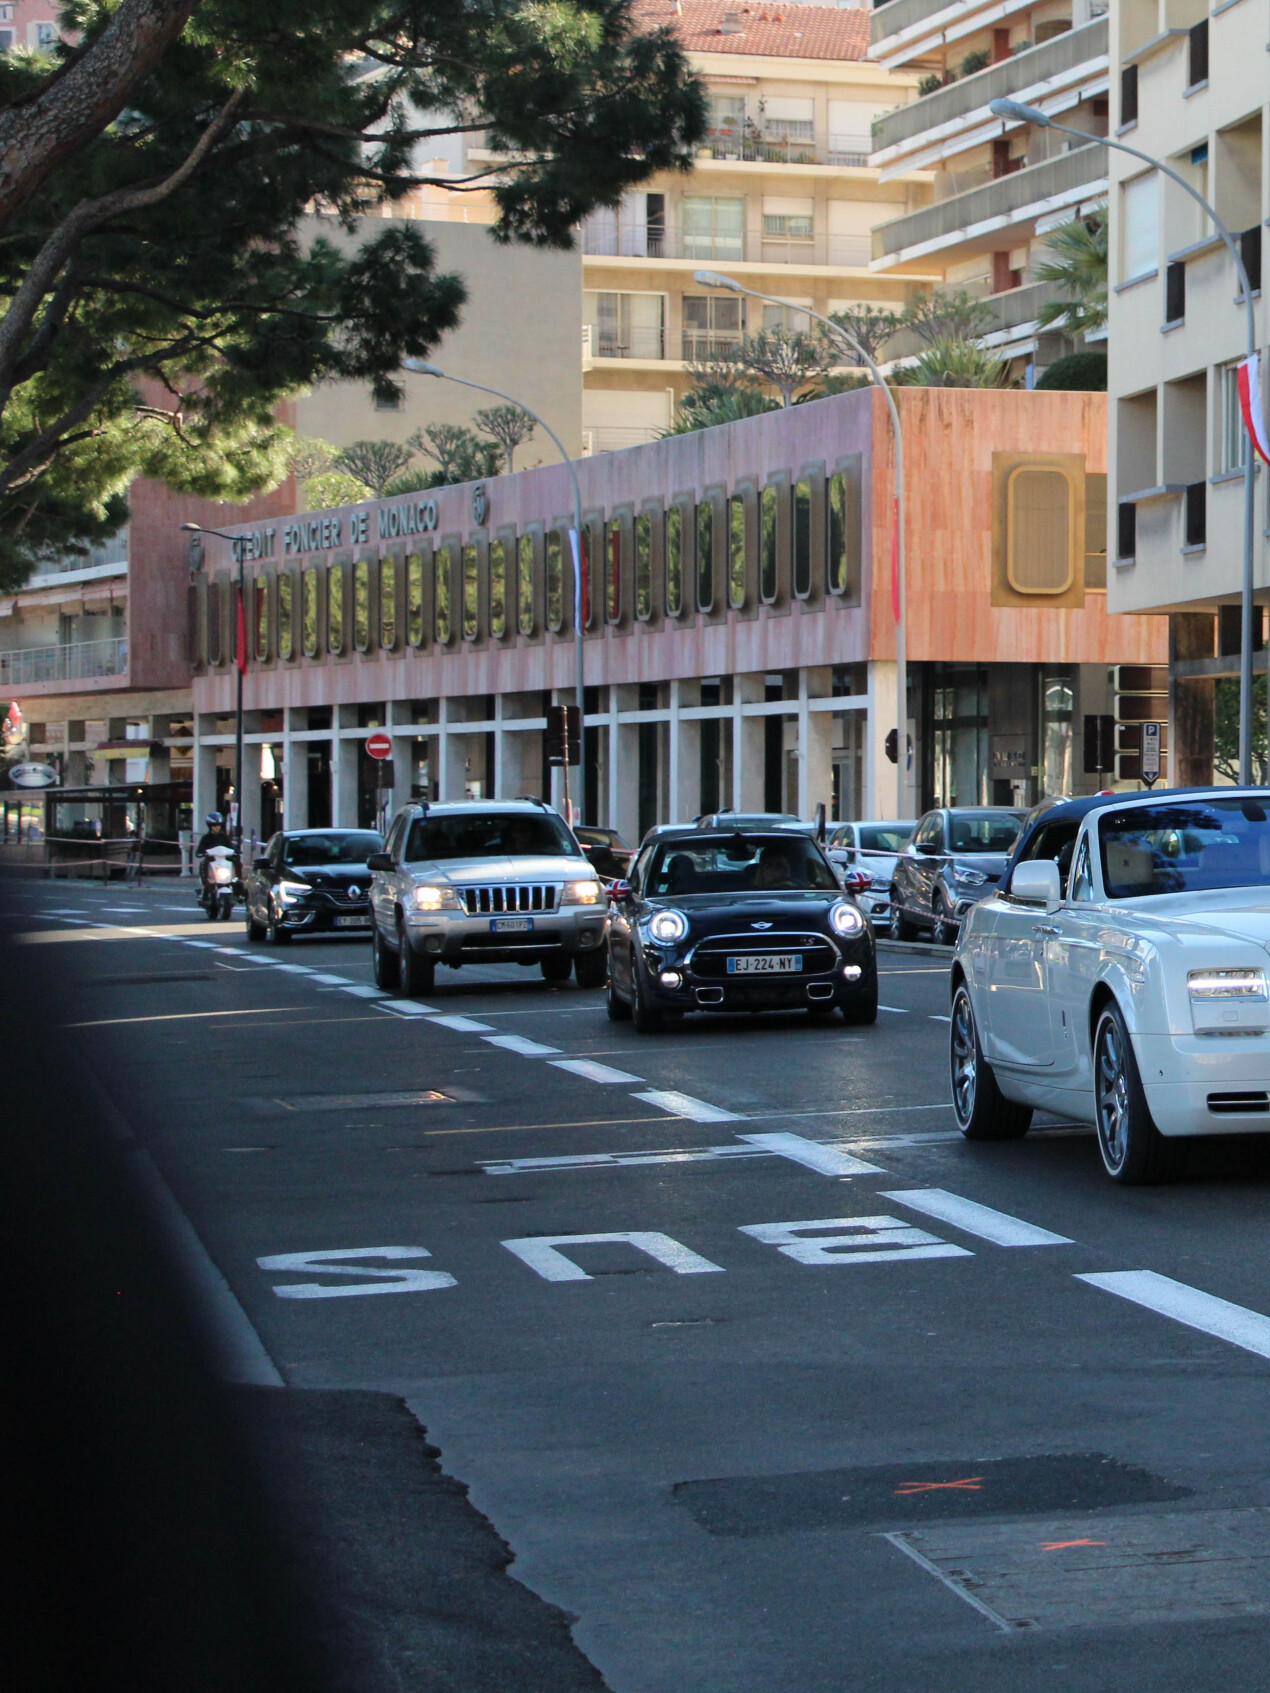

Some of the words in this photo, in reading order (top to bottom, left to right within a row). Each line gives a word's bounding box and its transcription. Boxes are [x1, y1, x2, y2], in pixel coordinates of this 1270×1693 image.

[283, 517, 341, 552] FONCIER
[351, 512, 369, 544] DE
[378, 499, 439, 539] MONACO
[735, 957, 793, 971] EJ-224-NY
[256, 1214, 977, 1299] BUS
